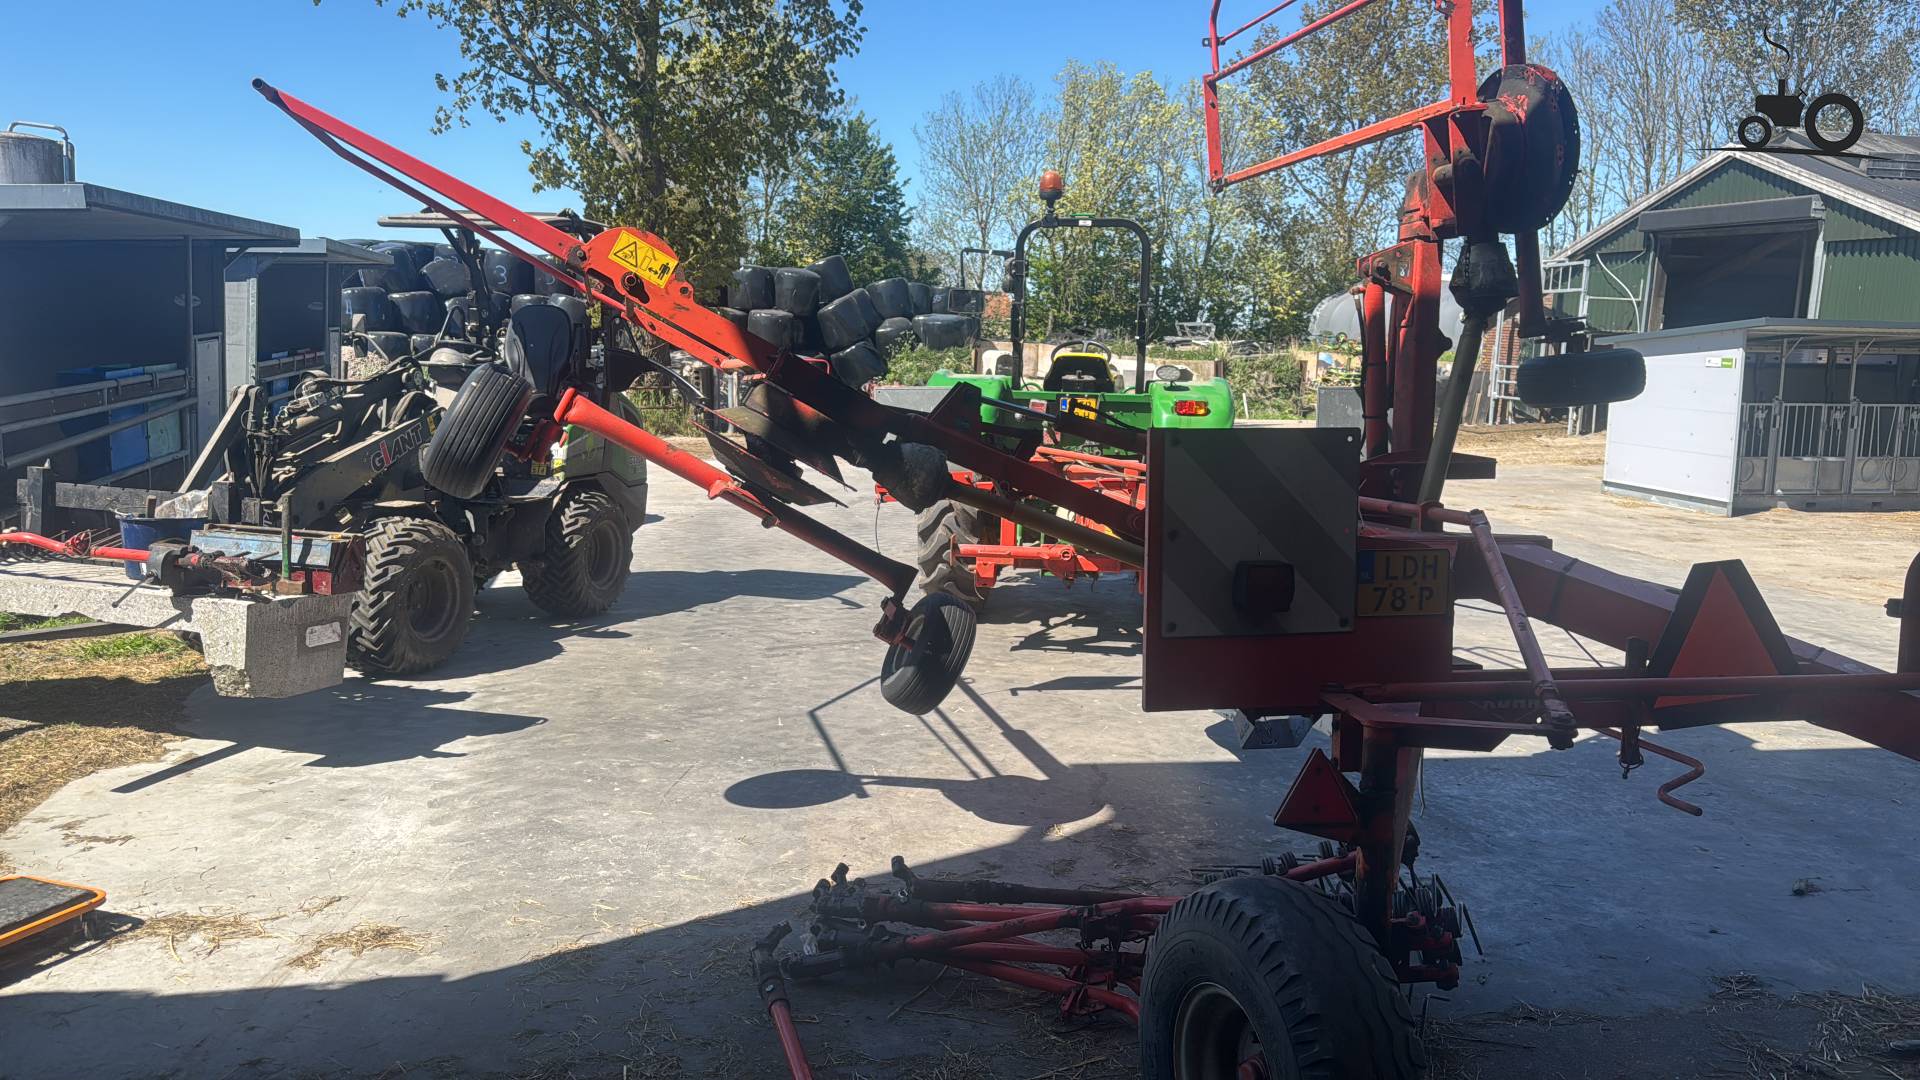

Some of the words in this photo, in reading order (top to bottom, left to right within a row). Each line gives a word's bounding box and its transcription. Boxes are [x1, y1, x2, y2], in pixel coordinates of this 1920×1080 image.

[493, 264, 508, 285] 3
[371, 422, 423, 473] GIANT
[1385, 555, 1438, 580] LDH
